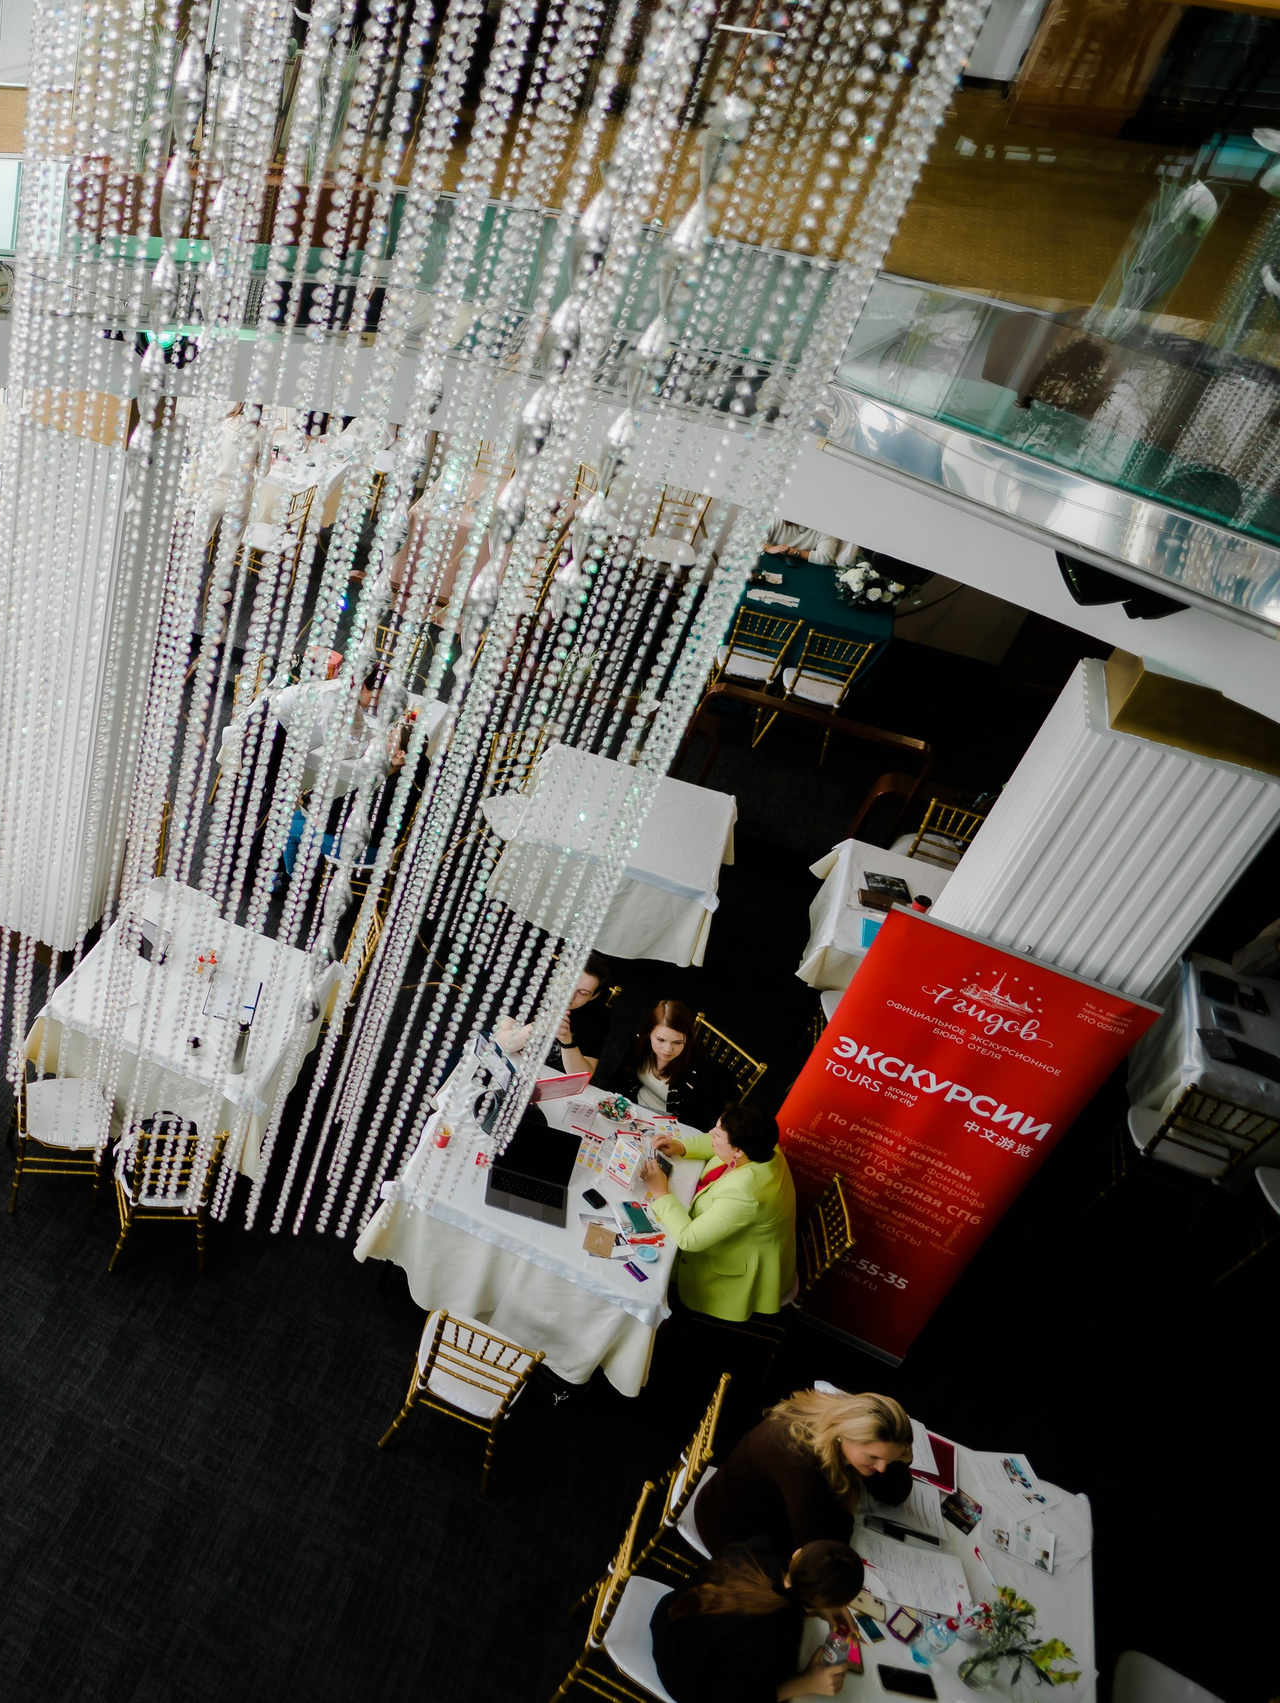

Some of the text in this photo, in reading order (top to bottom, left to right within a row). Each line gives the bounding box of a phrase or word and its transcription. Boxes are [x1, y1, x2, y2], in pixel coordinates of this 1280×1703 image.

[921, 984, 1053, 1048] 7 гидов
[1076, 1013, 1125, 1035] РТО 025119
[887, 1000, 1062, 1076] ОФИЦИАЛЬНОЕ ЭКСКУРСИОННОЕ
[933, 1027, 1002, 1060] БЮРО ОТЕЛЯ
[824, 1058, 883, 1092] TOURS
[833, 1036, 1051, 1141] ЭКСКУРСИИ
[886, 1085, 918, 1101] around
[883, 1090, 915, 1108] the city
[785, 1127, 860, 1165] Царское Село
[826, 1135, 905, 1176] ЭРМИТАЖ
[827, 1112, 971, 1181] По рекам и каналам
[855, 1137, 922, 1170] на кораблике
[862, 1116, 948, 1159] Невский проспект
[963, 1120, 1034, 1158] 中文游览
[822, 1167, 879, 1198] Сеейные
[861, 1166, 981, 1224] Обзорная СПб
[920, 1174, 986, 1209] Петергофа
[926, 1167, 980, 1197] Фонтаны
[883, 1189, 952, 1226] Кронштадт
[891, 1210, 942, 1237] крепость
